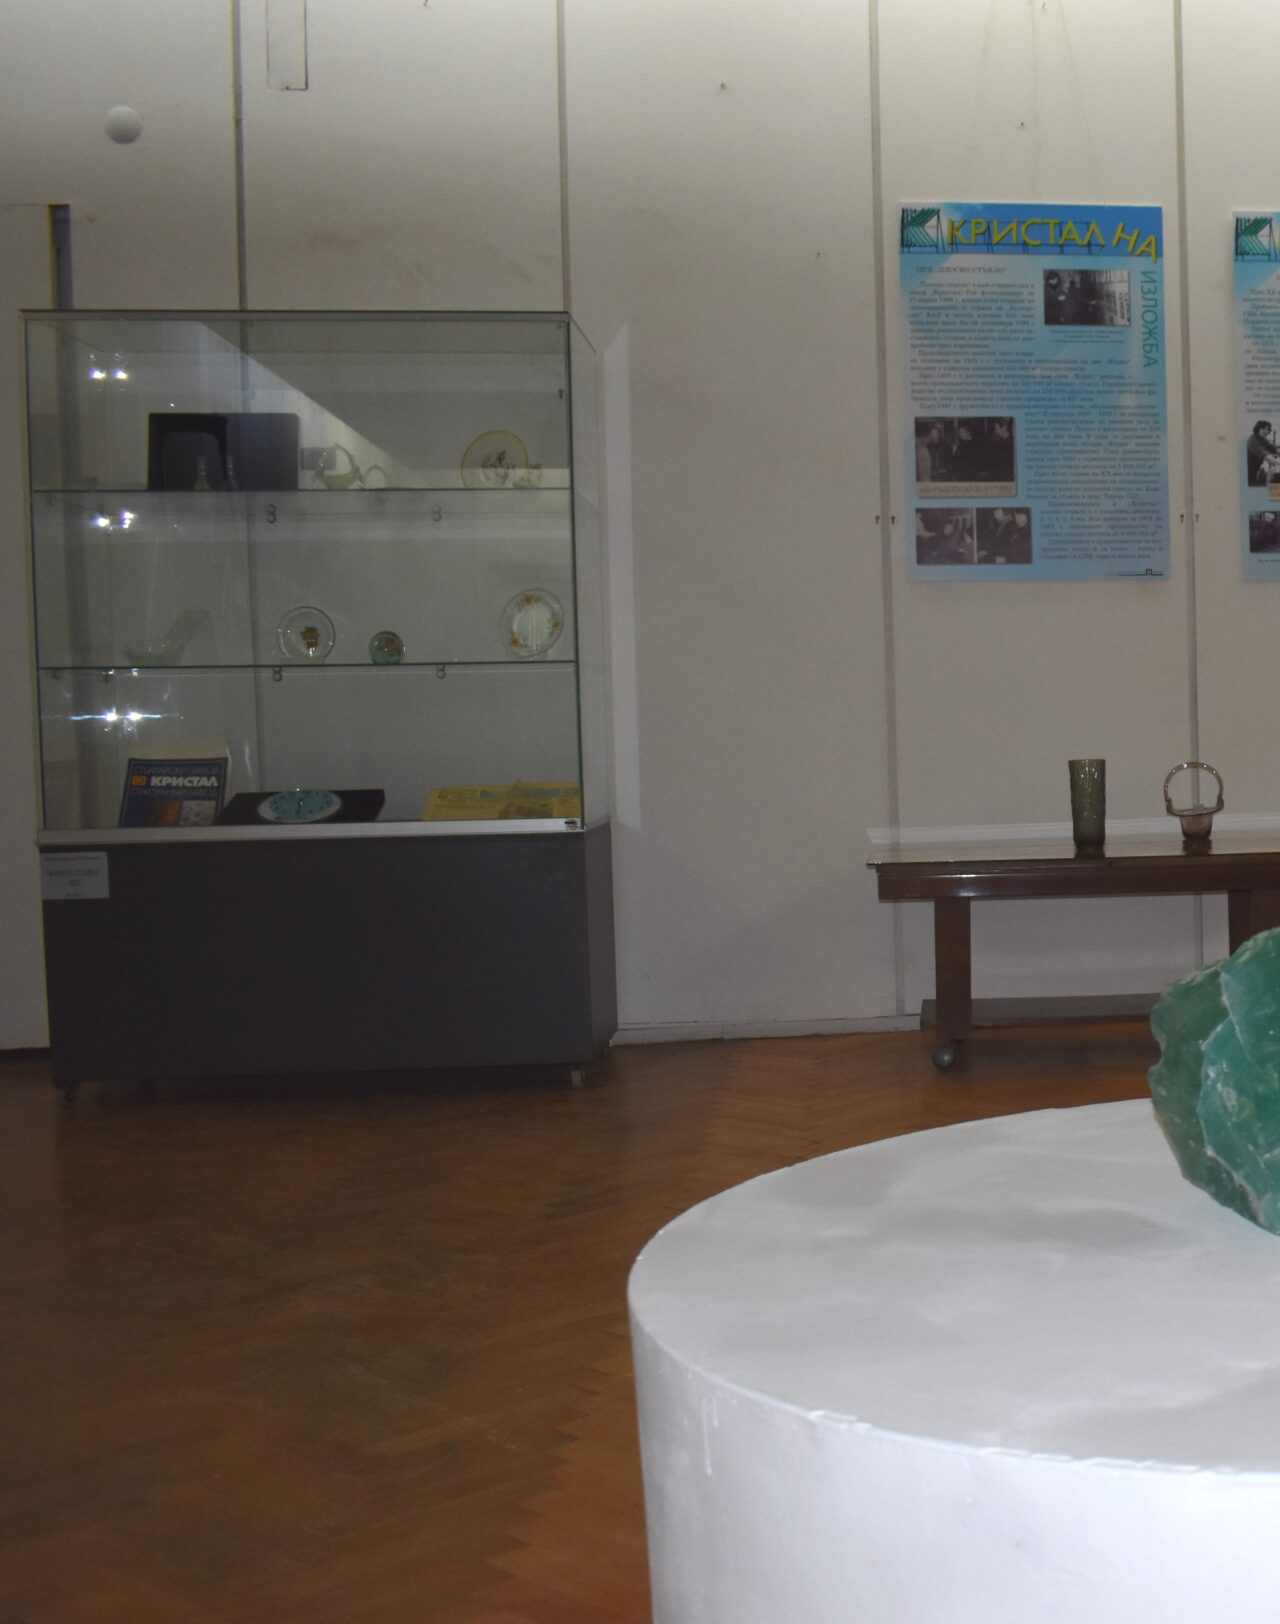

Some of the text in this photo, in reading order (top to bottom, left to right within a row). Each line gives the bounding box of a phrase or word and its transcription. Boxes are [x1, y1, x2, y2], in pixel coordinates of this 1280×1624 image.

[945, 218, 1158, 264] КРИСТАЛ НА
[1140, 269, 1160, 369] ИЗЛОЖБА
[150, 775, 219, 787] КРИСТАЛ
